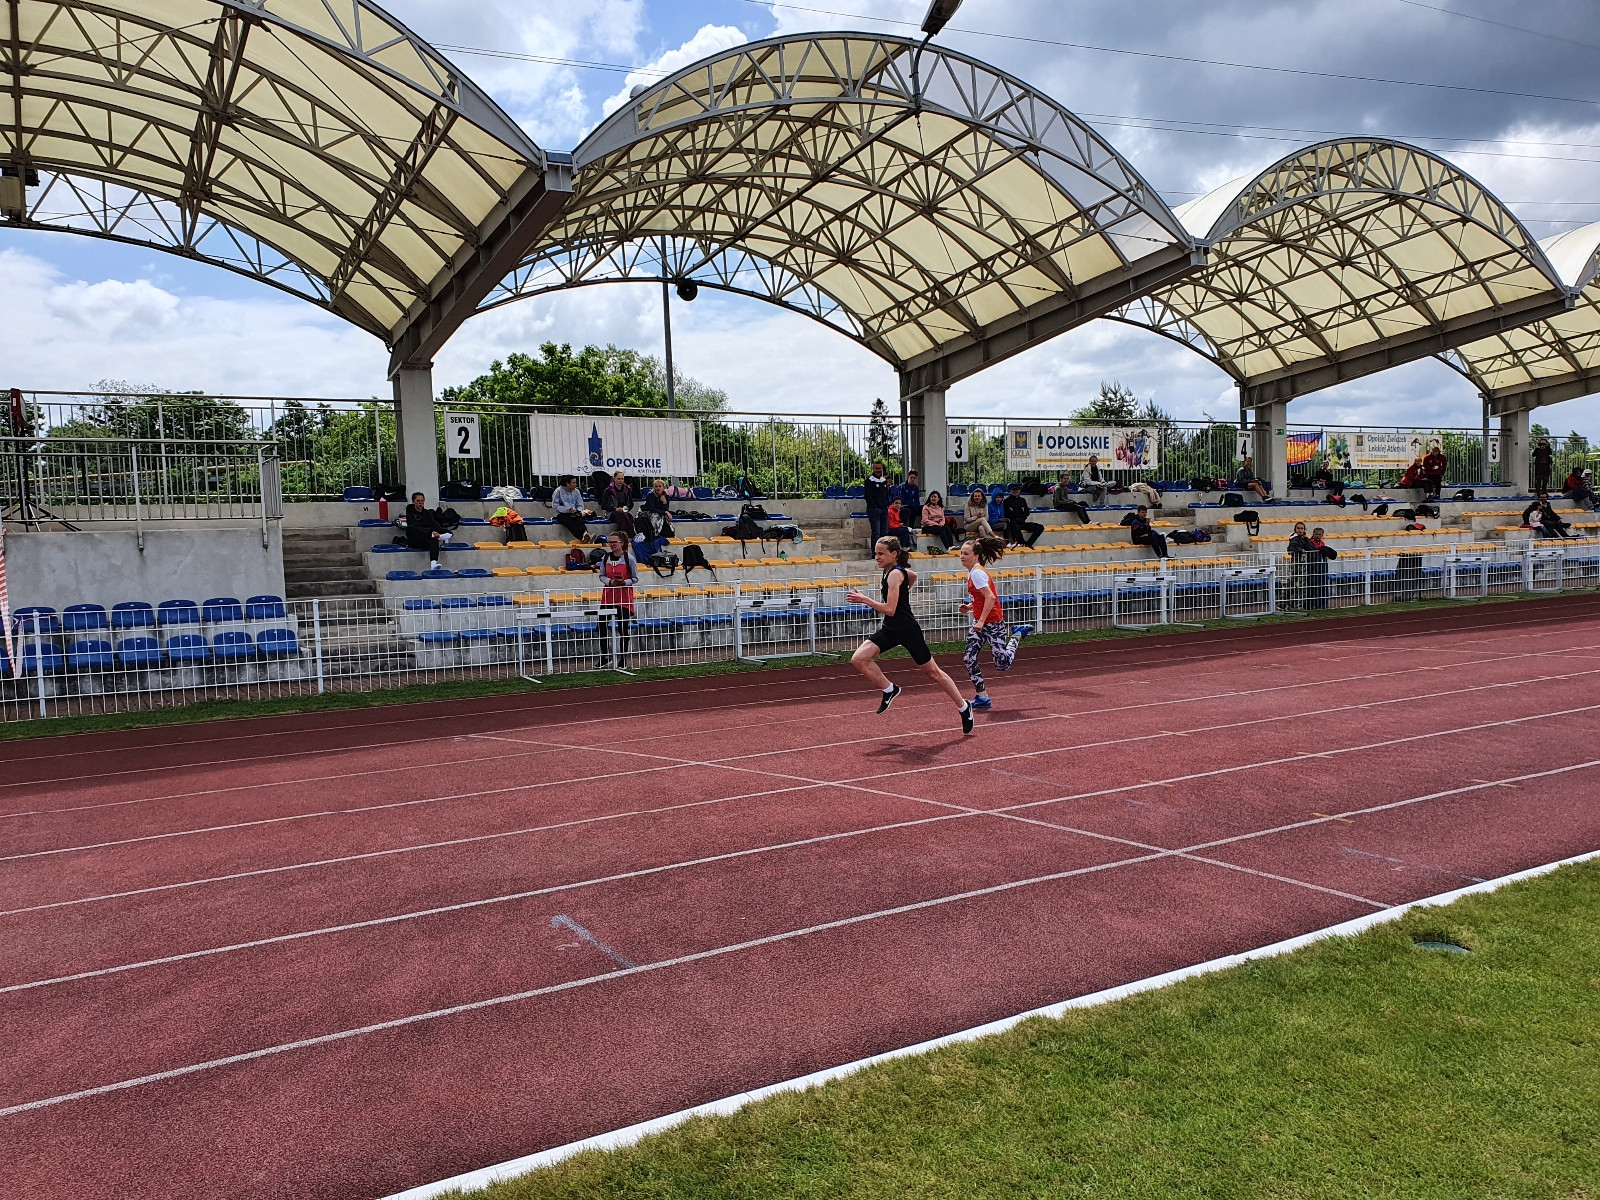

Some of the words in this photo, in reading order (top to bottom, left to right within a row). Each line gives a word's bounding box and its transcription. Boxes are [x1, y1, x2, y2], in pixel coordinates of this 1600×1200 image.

[450, 416, 475, 424] SEKTOR
[457, 426, 471, 454] 2
[954, 435, 963, 459] 3
[1046, 435, 1110, 450] OPOLSKIE
[1240, 439, 1248, 459] 4
[1491, 443, 1497, 460] 5
[606, 457, 662, 468] OPOLSKIE
